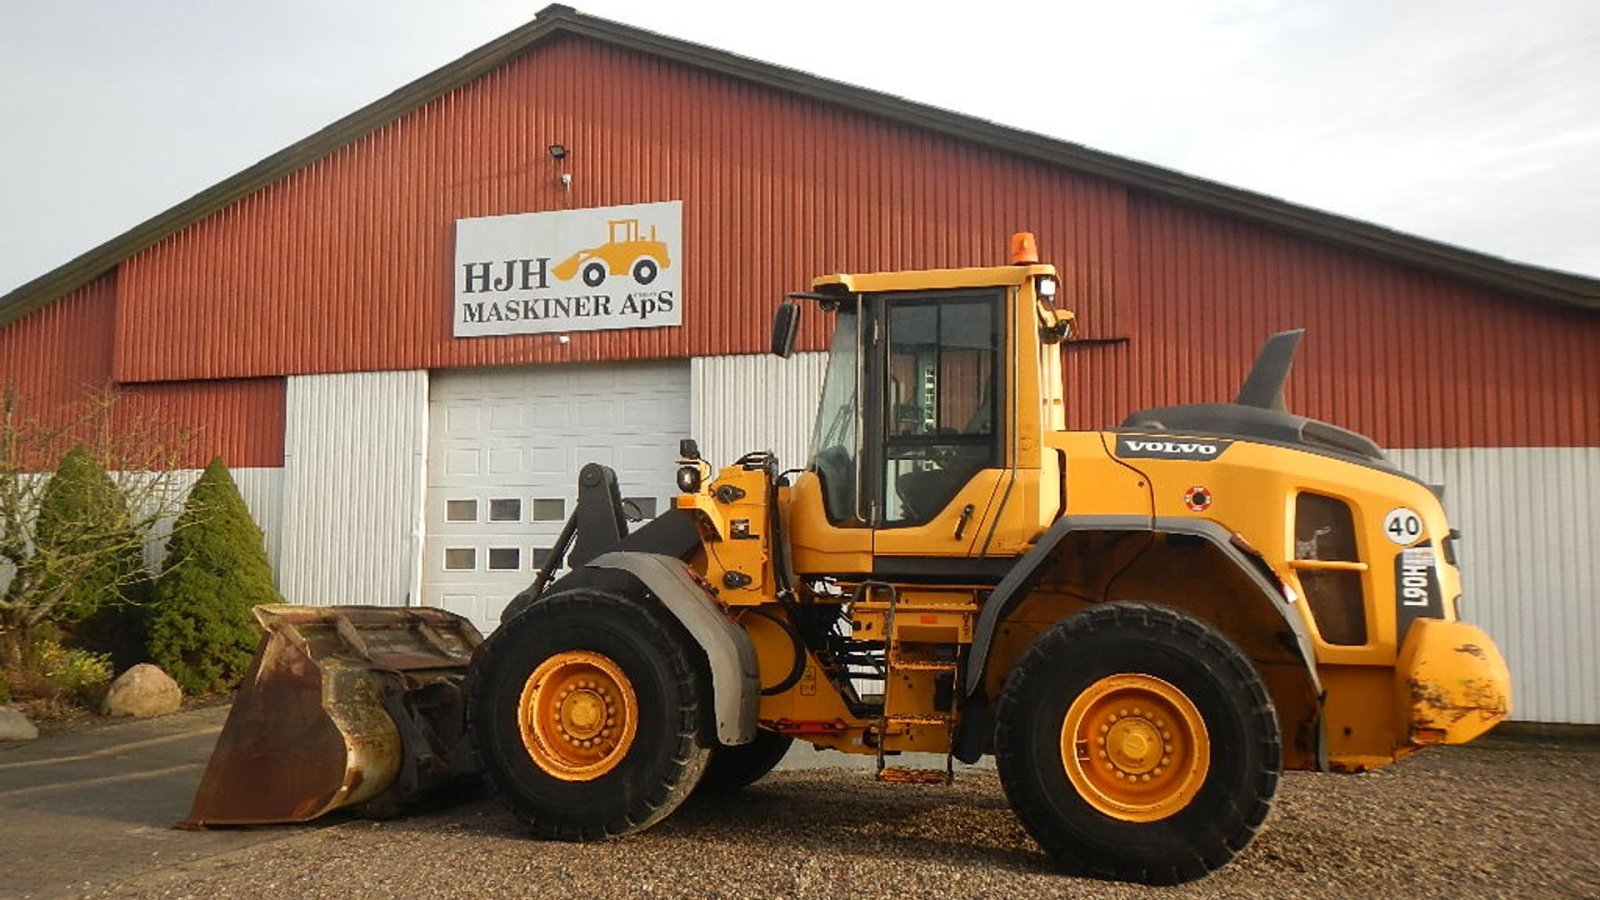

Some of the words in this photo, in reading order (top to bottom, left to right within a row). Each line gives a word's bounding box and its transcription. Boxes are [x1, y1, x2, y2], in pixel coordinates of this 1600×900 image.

[462, 258, 550, 293] HJH
[462, 295, 611, 323] MASKINER
[619, 290, 673, 320] ApS
[1125, 440, 1217, 454] VOLVO
[1388, 516, 1419, 536] 40
[1402, 565, 1428, 606] L90H
